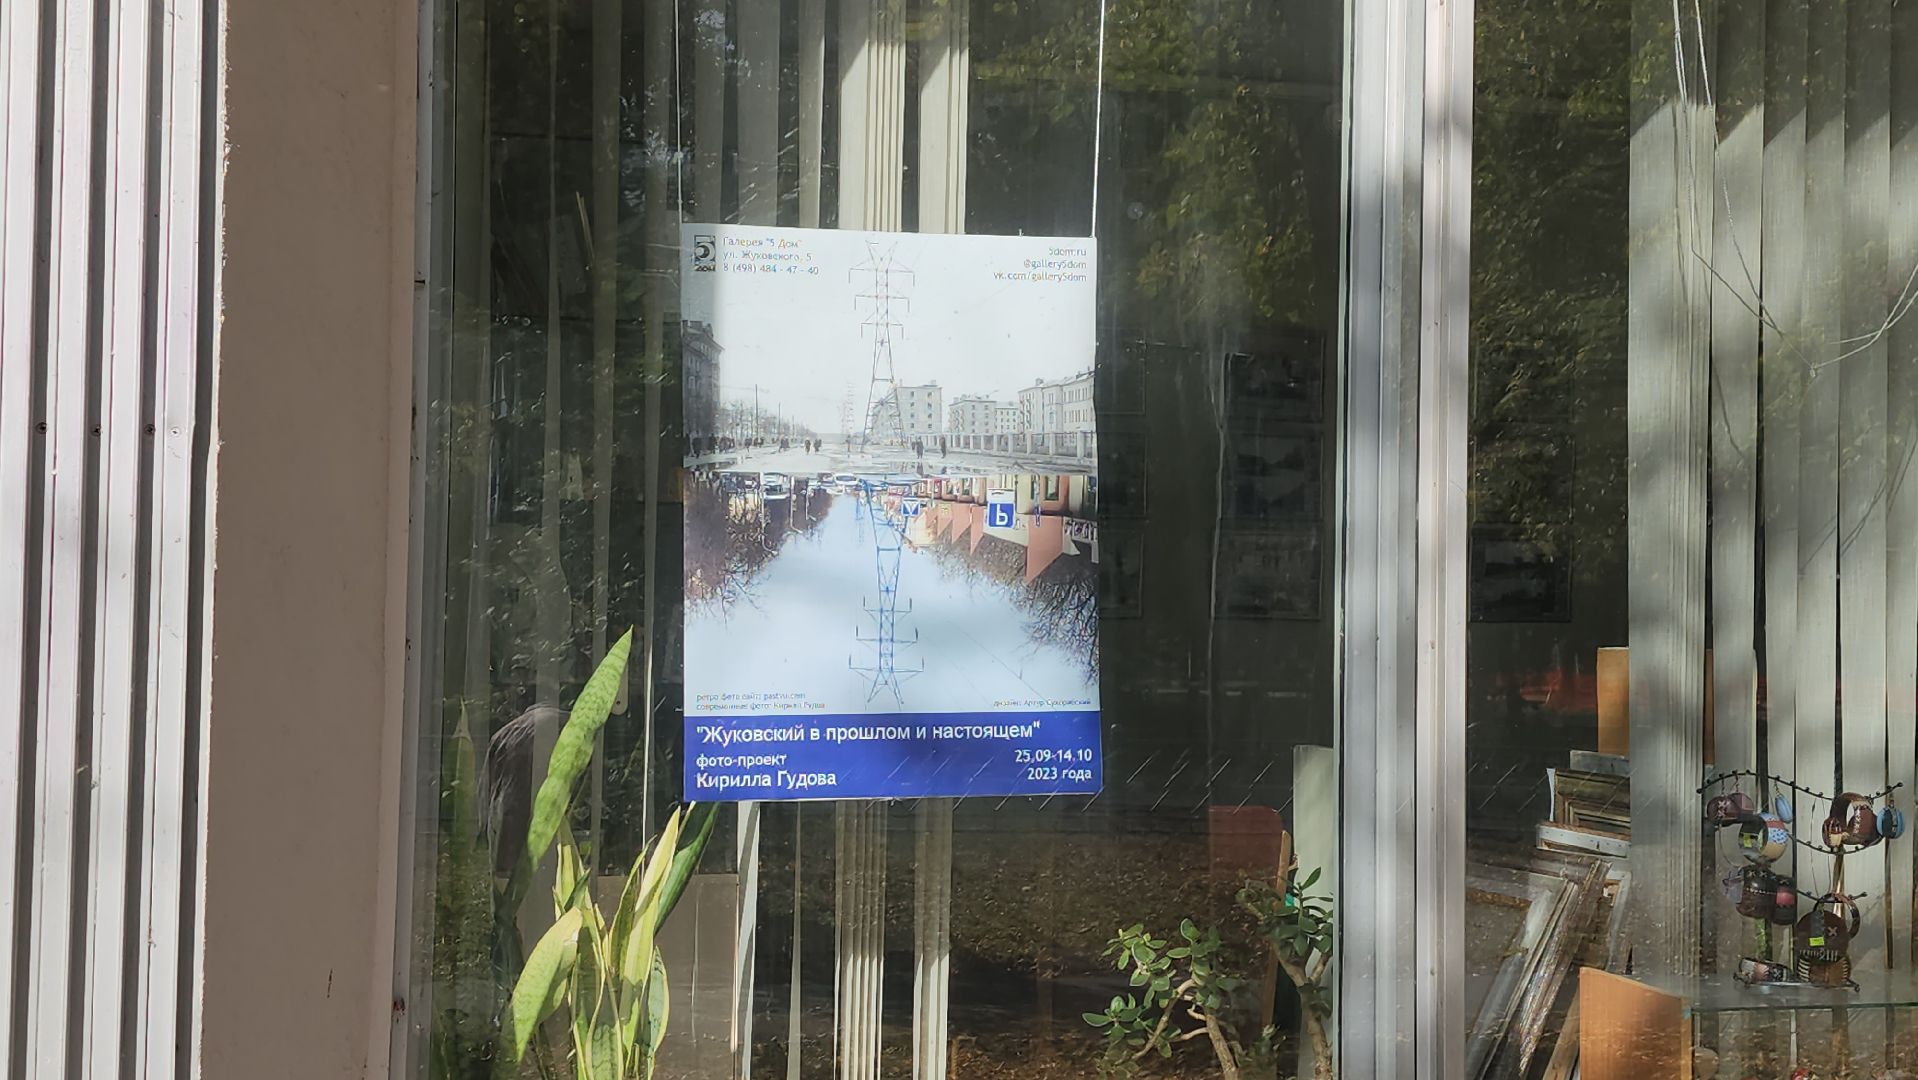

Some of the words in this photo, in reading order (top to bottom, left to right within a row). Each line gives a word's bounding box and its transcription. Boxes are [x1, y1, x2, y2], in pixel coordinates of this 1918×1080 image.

[723, 237, 763, 247] Галерея
[723, 252, 738, 260] ул.
[806, 253, 812, 261] 5
[723, 264, 729, 272] 8
[732, 264, 757, 273] (498)
[760, 265, 777, 273] 484
[787, 266, 797, 274] 47
[696, 725, 805, 748] "Жуковский
[810, 729, 820, 740] в
[826, 726, 911, 744] прошлом
[916, 726, 927, 739] и
[933, 720, 1041, 740] настоящем"
[696, 753, 787, 770] фото-проект
[1015, 749, 1092, 763] 25.09-14.10
[696, 772, 771, 792] Кирилла
[777, 770, 837, 790] Гудова
[1027, 767, 1058, 780] 2023
[1062, 769, 1092, 782] года
